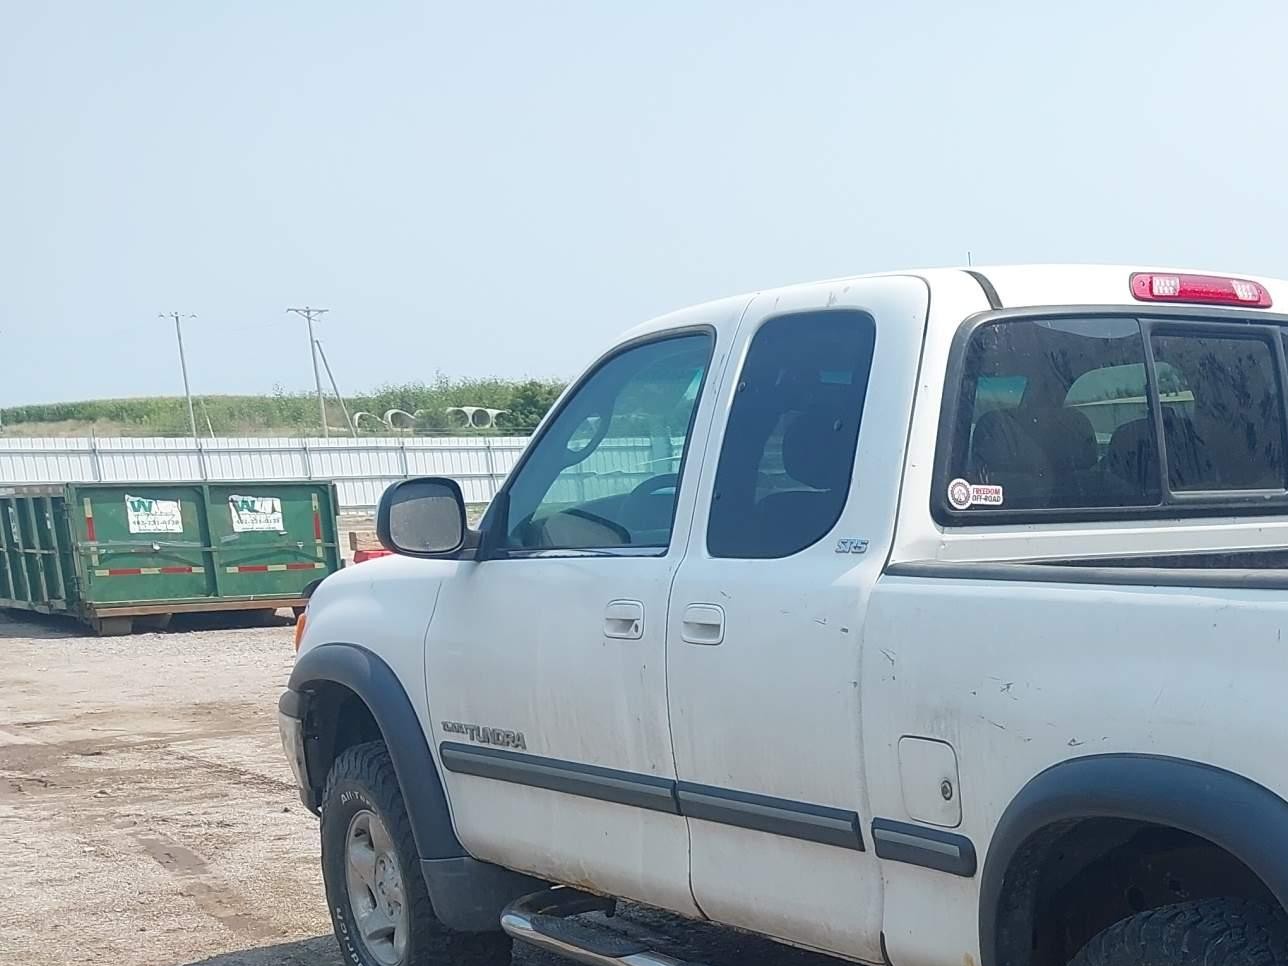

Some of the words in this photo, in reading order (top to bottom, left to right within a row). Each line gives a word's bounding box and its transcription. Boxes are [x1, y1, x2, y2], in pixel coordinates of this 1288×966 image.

[972, 487, 1001, 495] FREEDOM
[972, 495, 1001, 503] OFF-ROAD
[835, 539, 869, 553] SR5
[464, 725, 527, 750] TUNDRA
